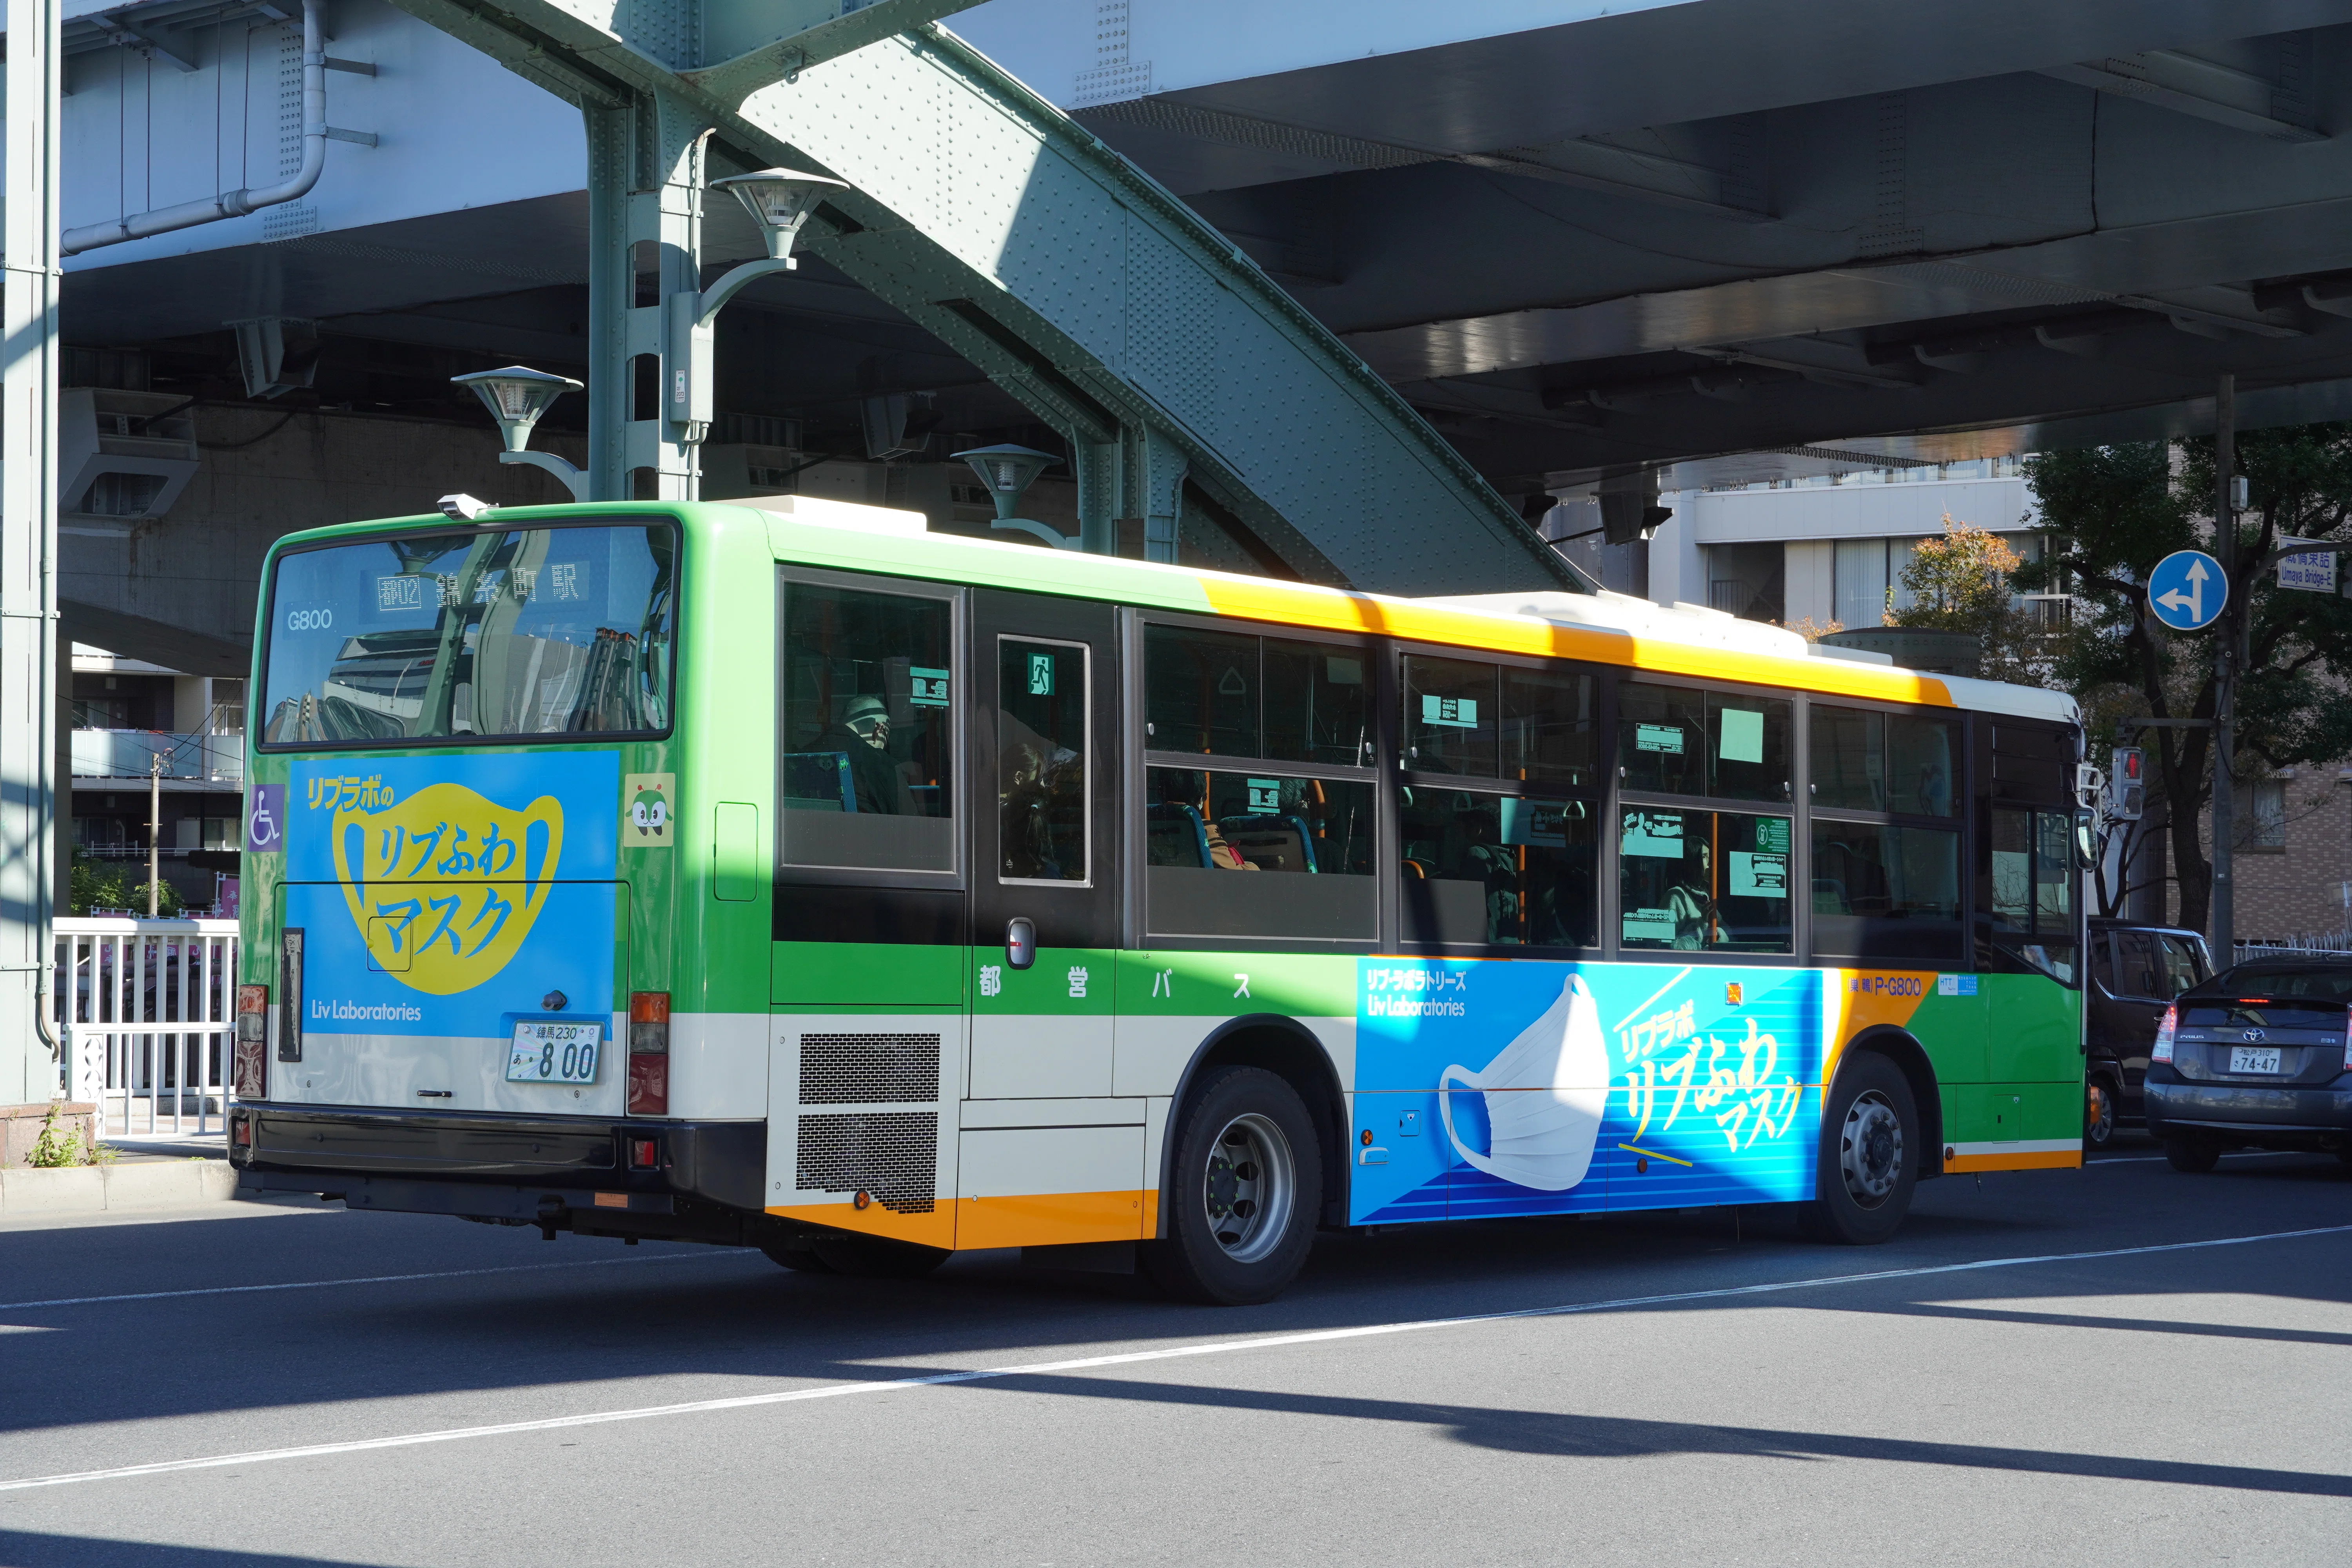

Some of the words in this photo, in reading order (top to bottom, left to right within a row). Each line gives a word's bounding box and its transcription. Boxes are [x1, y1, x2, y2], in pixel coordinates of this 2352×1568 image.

[435, 564, 579, 608] 錦糸町駅
[2282, 566, 2302, 585] Umaya
[2305, 569, 2333, 587] Bridge-E.
[288, 609, 332, 631] G800
[308, 774, 394, 810] リブラボの
[380, 821, 516, 878] リブふわ
[376, 887, 512, 959] マスク
[1875, 976, 1921, 996] P-G800
[312, 999, 331, 1019] Liv
[333, 1000, 421, 1021] Laboratories
[1368, 994, 1386, 1016] Liv
[1387, 995, 1465, 1016] Laboratories
[1621, 999, 1696, 1063] リブラボ
[513, 1053, 521, 1065] あ
[2241, 1057, 2277, 1071] 74-47
[1625, 1018, 1777, 1143] リブふわ
[1715, 1076, 1803, 1153] マスク
